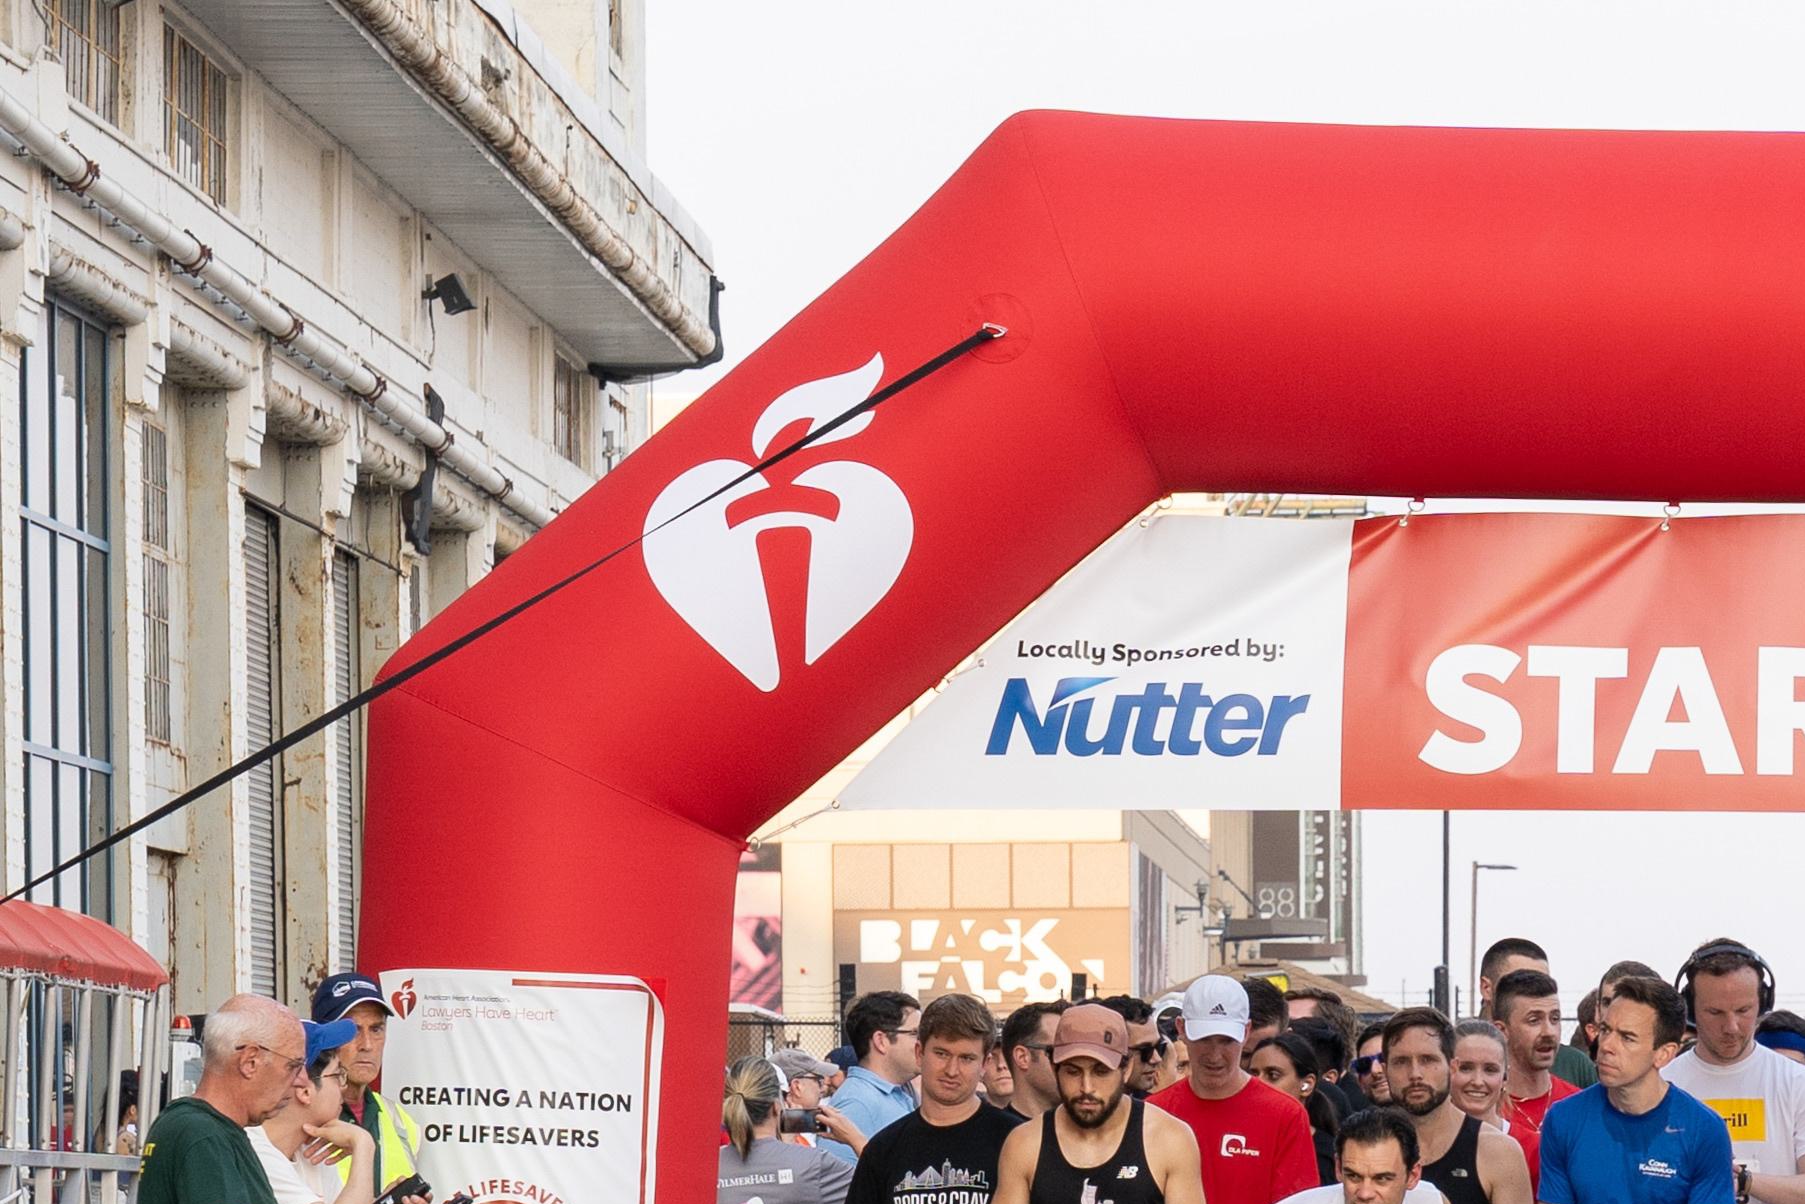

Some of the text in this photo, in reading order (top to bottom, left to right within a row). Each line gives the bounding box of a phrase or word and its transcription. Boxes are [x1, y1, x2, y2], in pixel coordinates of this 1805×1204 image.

[1017, 638, 1286, 667] Locally Sponsored by:
[984, 675, 1311, 758] Nutter
[1259, 887, 1295, 918] 88
[860, 918, 1060, 963] BLACK
[421, 1021, 453, 1031] Boston
[422, 1006, 471, 1020] Lawyers
[476, 1006, 511, 1019] Have
[399, 1086, 631, 1112] CREATING A NATION
[425, 1124, 599, 1148] OF LIFESAVERS
